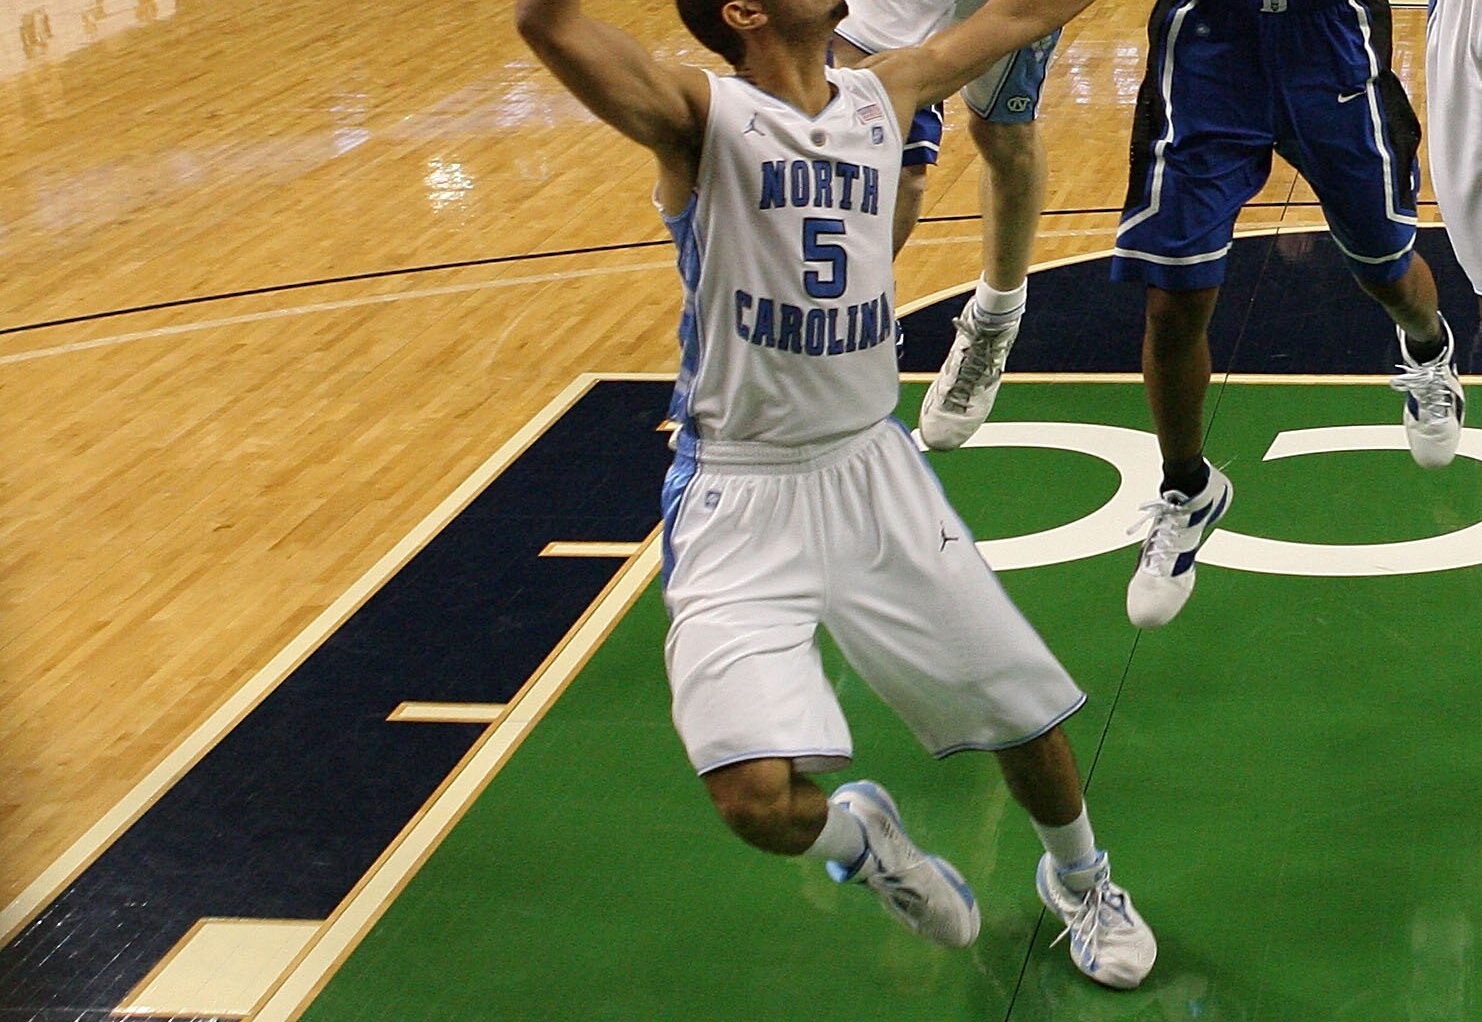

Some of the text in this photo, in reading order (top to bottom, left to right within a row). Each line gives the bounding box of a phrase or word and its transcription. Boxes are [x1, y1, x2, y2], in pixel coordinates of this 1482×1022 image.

[759, 160, 880, 216] NORTH
[803, 217, 848, 299] 5
[734, 289, 891, 357] CAROLINA
